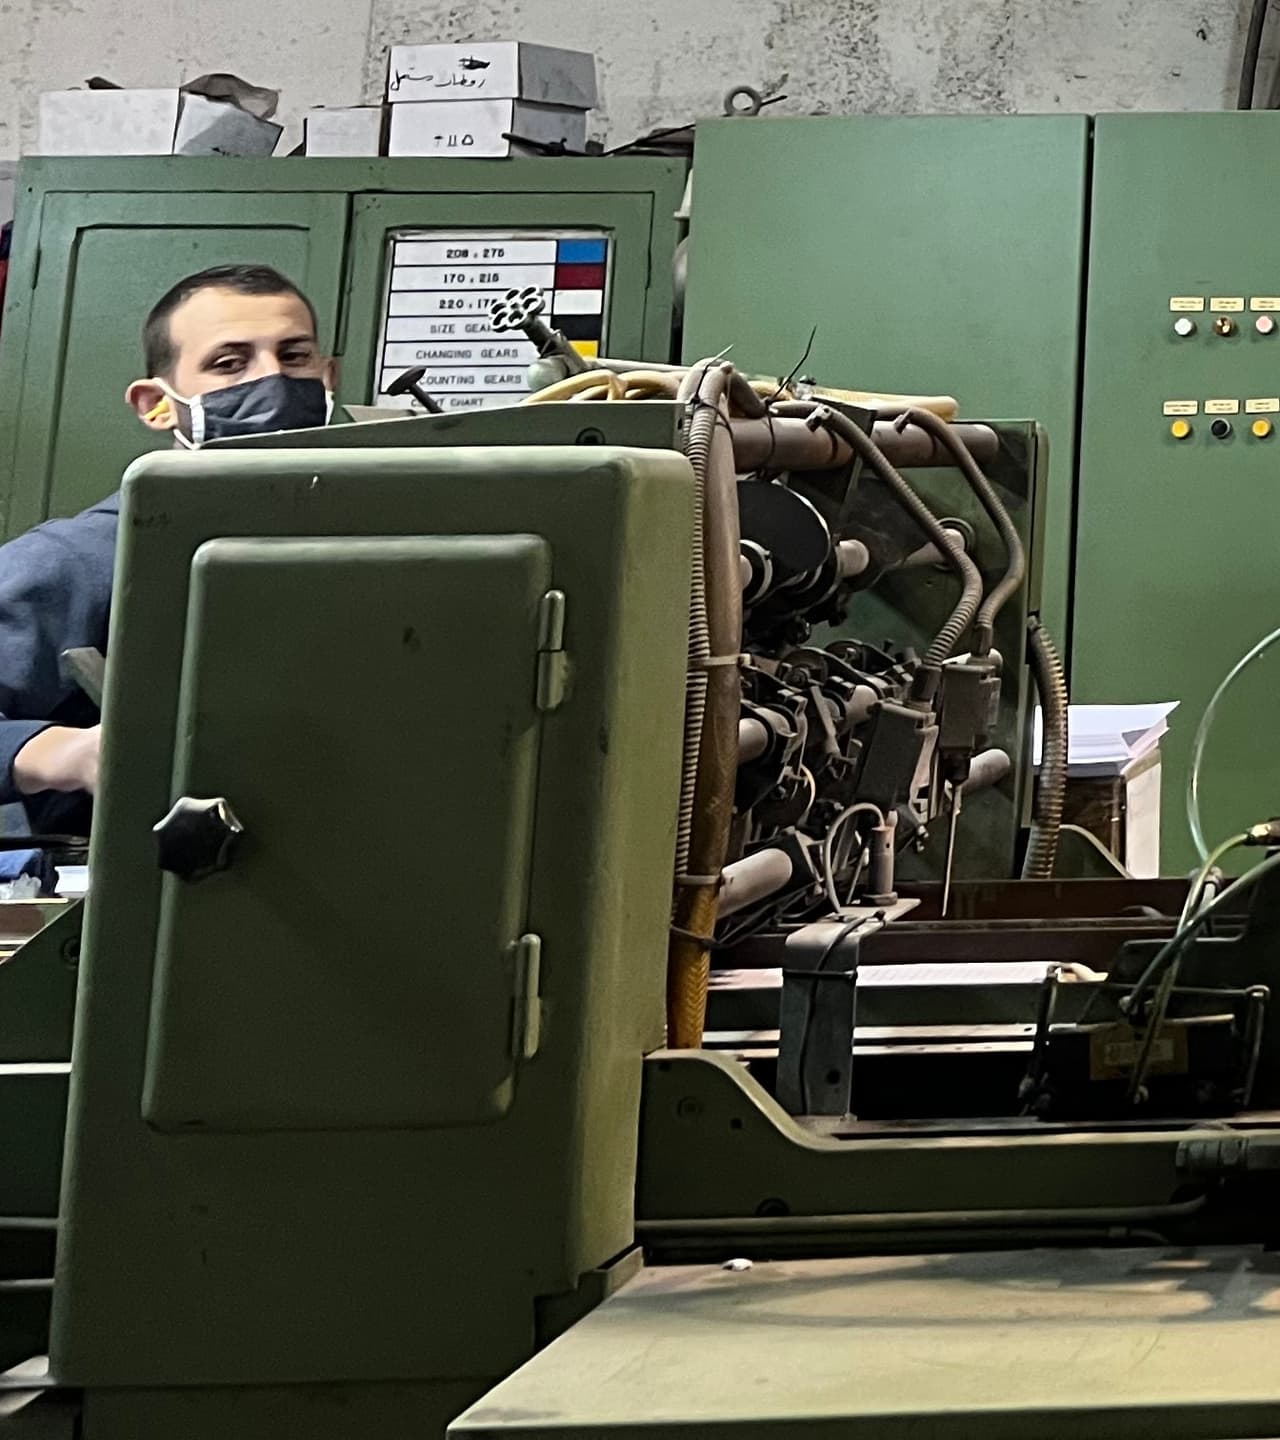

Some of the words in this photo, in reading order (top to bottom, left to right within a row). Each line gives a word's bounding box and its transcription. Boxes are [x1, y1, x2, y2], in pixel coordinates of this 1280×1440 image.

[443, 273, 466, 284] 170
[439, 298, 465, 310] 220
[430, 323, 455, 334] SIZE
[464, 323, 491, 333] GEA
[415, 349, 473, 360] CHANGING
[480, 348, 519, 359] GEARS
[418, 374, 476, 386] COUNTING
[483, 374, 522, 385] GEARS
[450, 397, 485, 408] CHART
